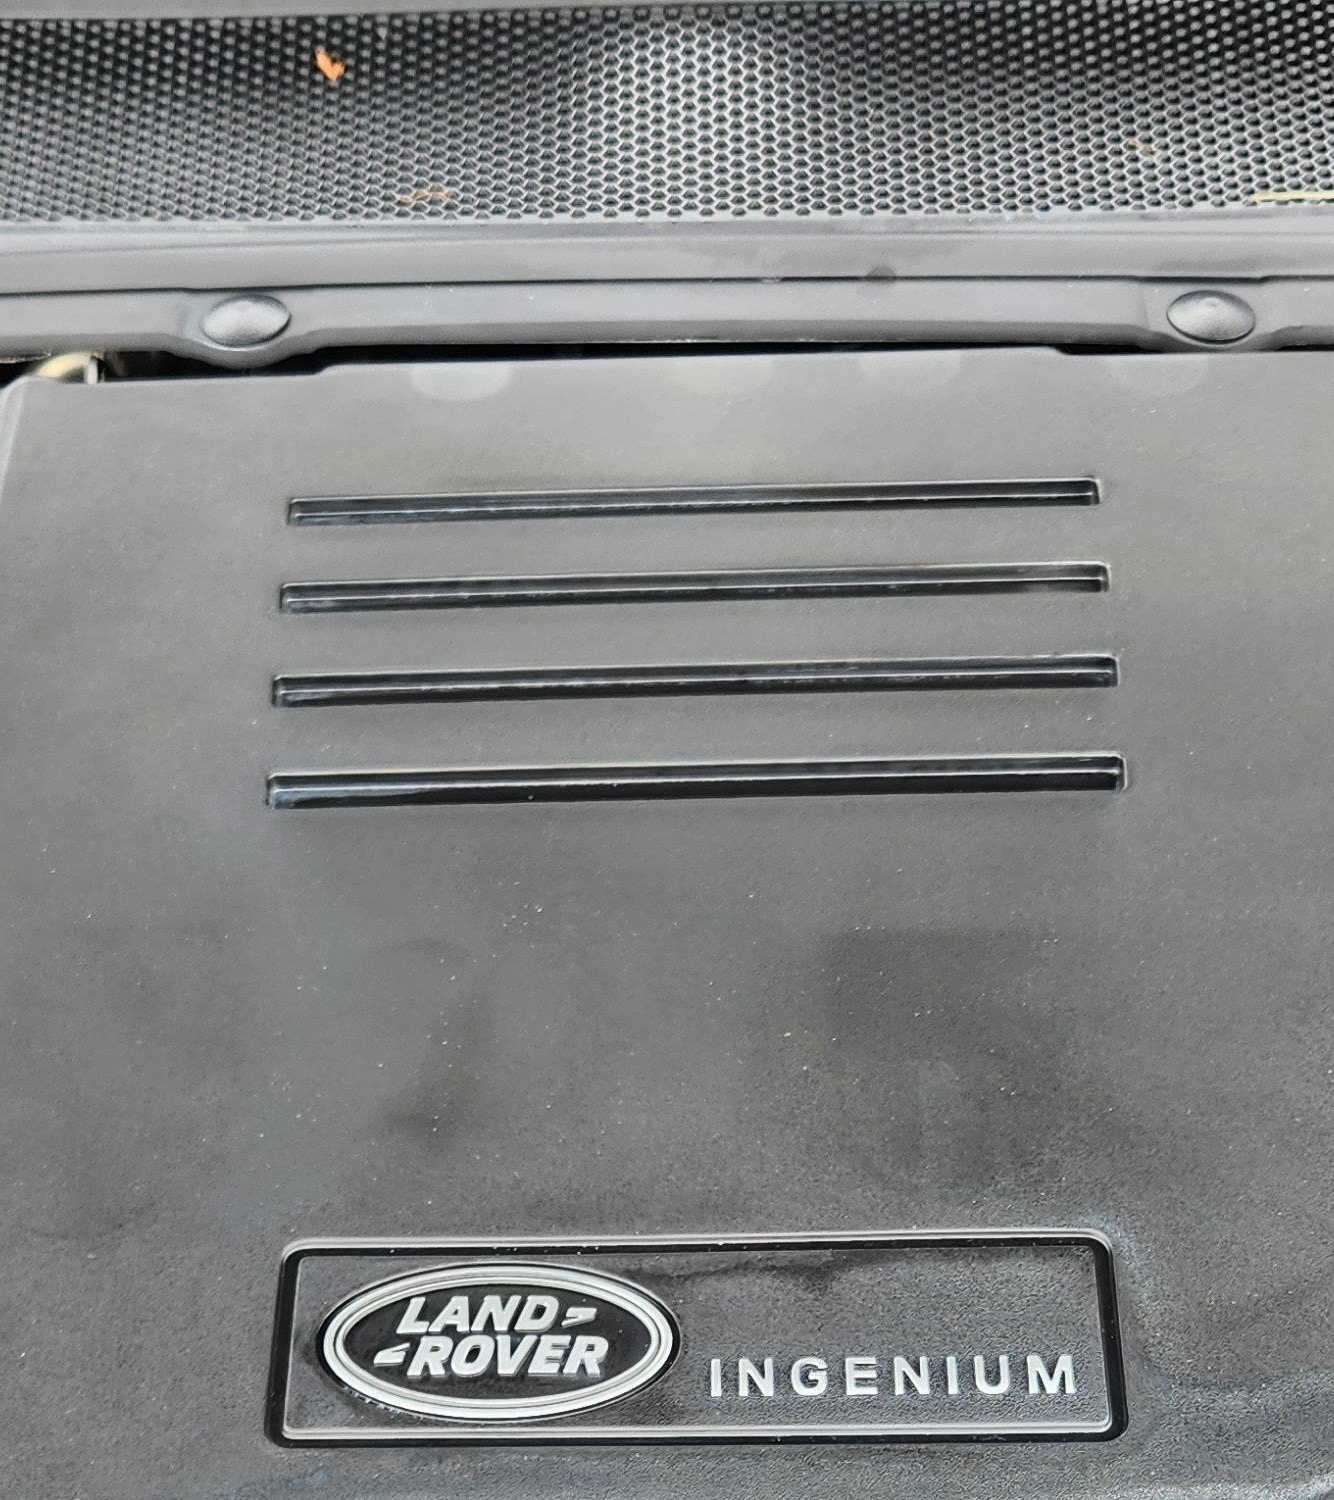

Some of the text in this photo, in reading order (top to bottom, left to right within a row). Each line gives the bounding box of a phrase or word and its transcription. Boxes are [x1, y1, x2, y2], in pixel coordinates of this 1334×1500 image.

[396, 1294, 560, 1335] LAND
[406, 1334, 610, 1379] ROVER
[709, 1353, 1077, 1398] INGENIUM
